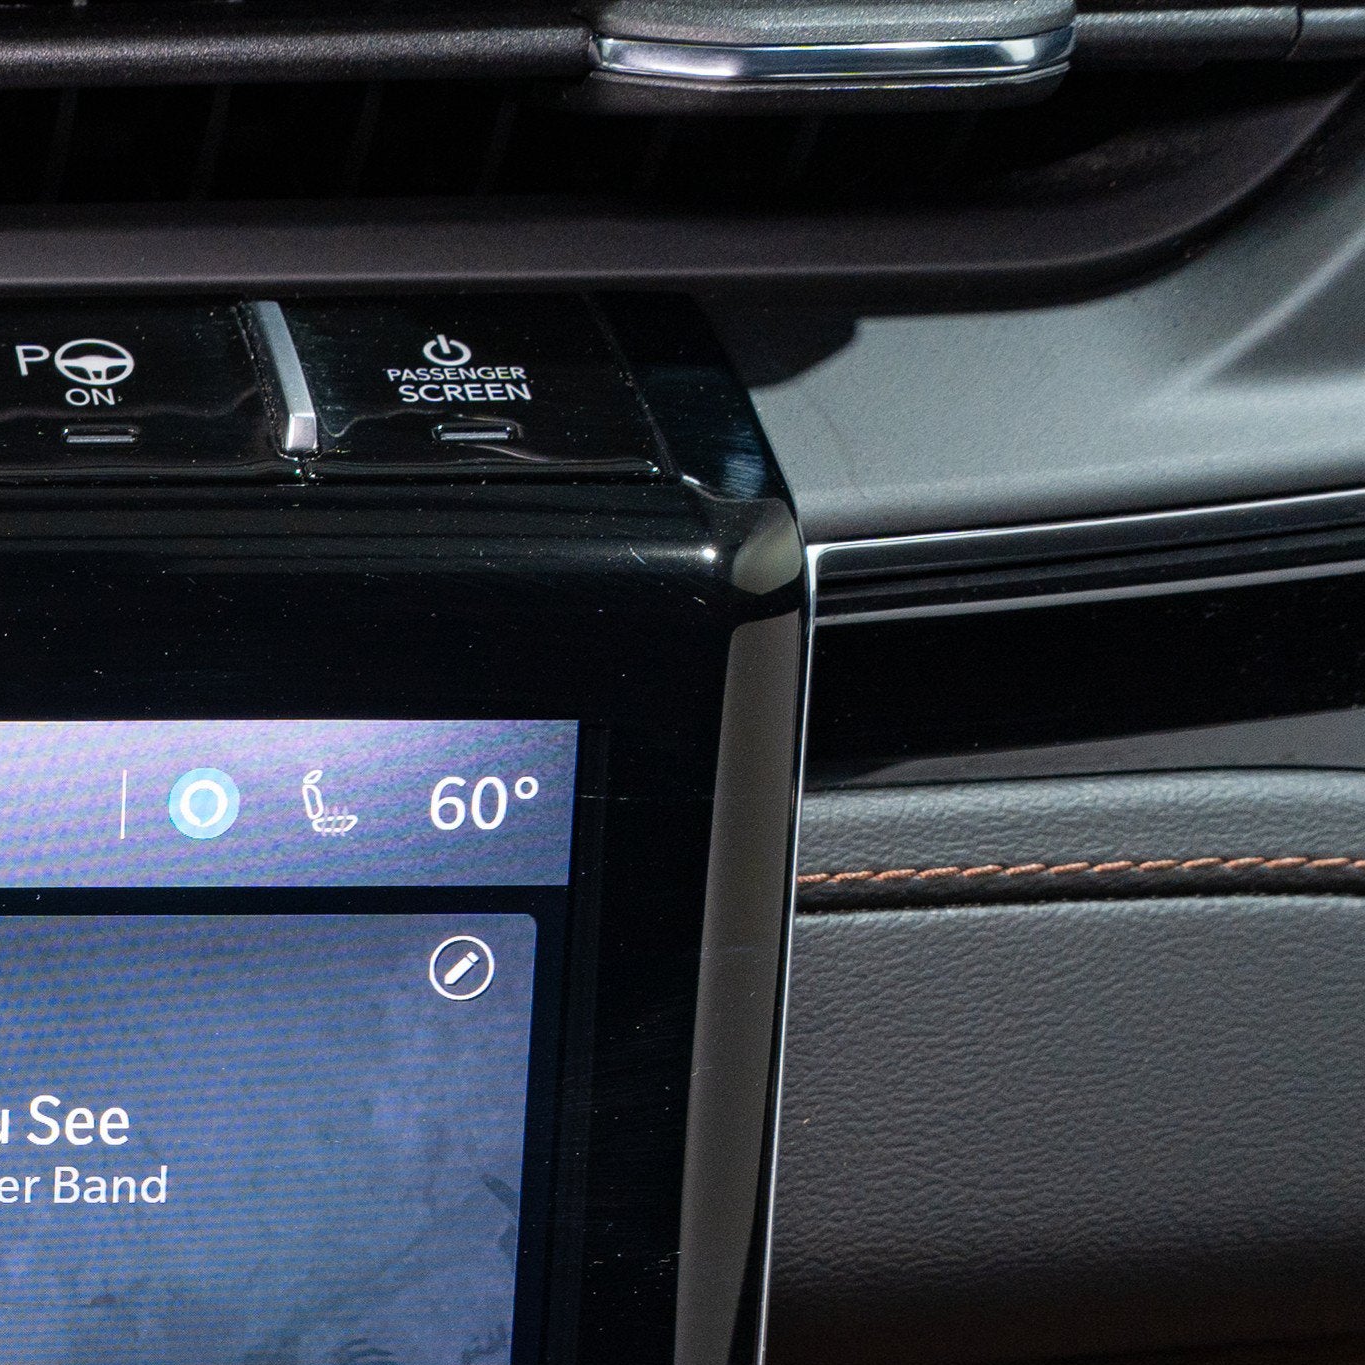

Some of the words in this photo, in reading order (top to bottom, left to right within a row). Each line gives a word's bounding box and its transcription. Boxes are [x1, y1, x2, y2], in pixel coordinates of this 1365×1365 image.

[16, 344, 50, 377] P
[387, 365, 527, 382] PASSENGER
[66, 388, 116, 407] ON
[399, 383, 531, 404] SCREEN
[429, 776, 540, 831] 60°
[26, 1095, 131, 1146] See
[54, 1165, 169, 1205] Band
